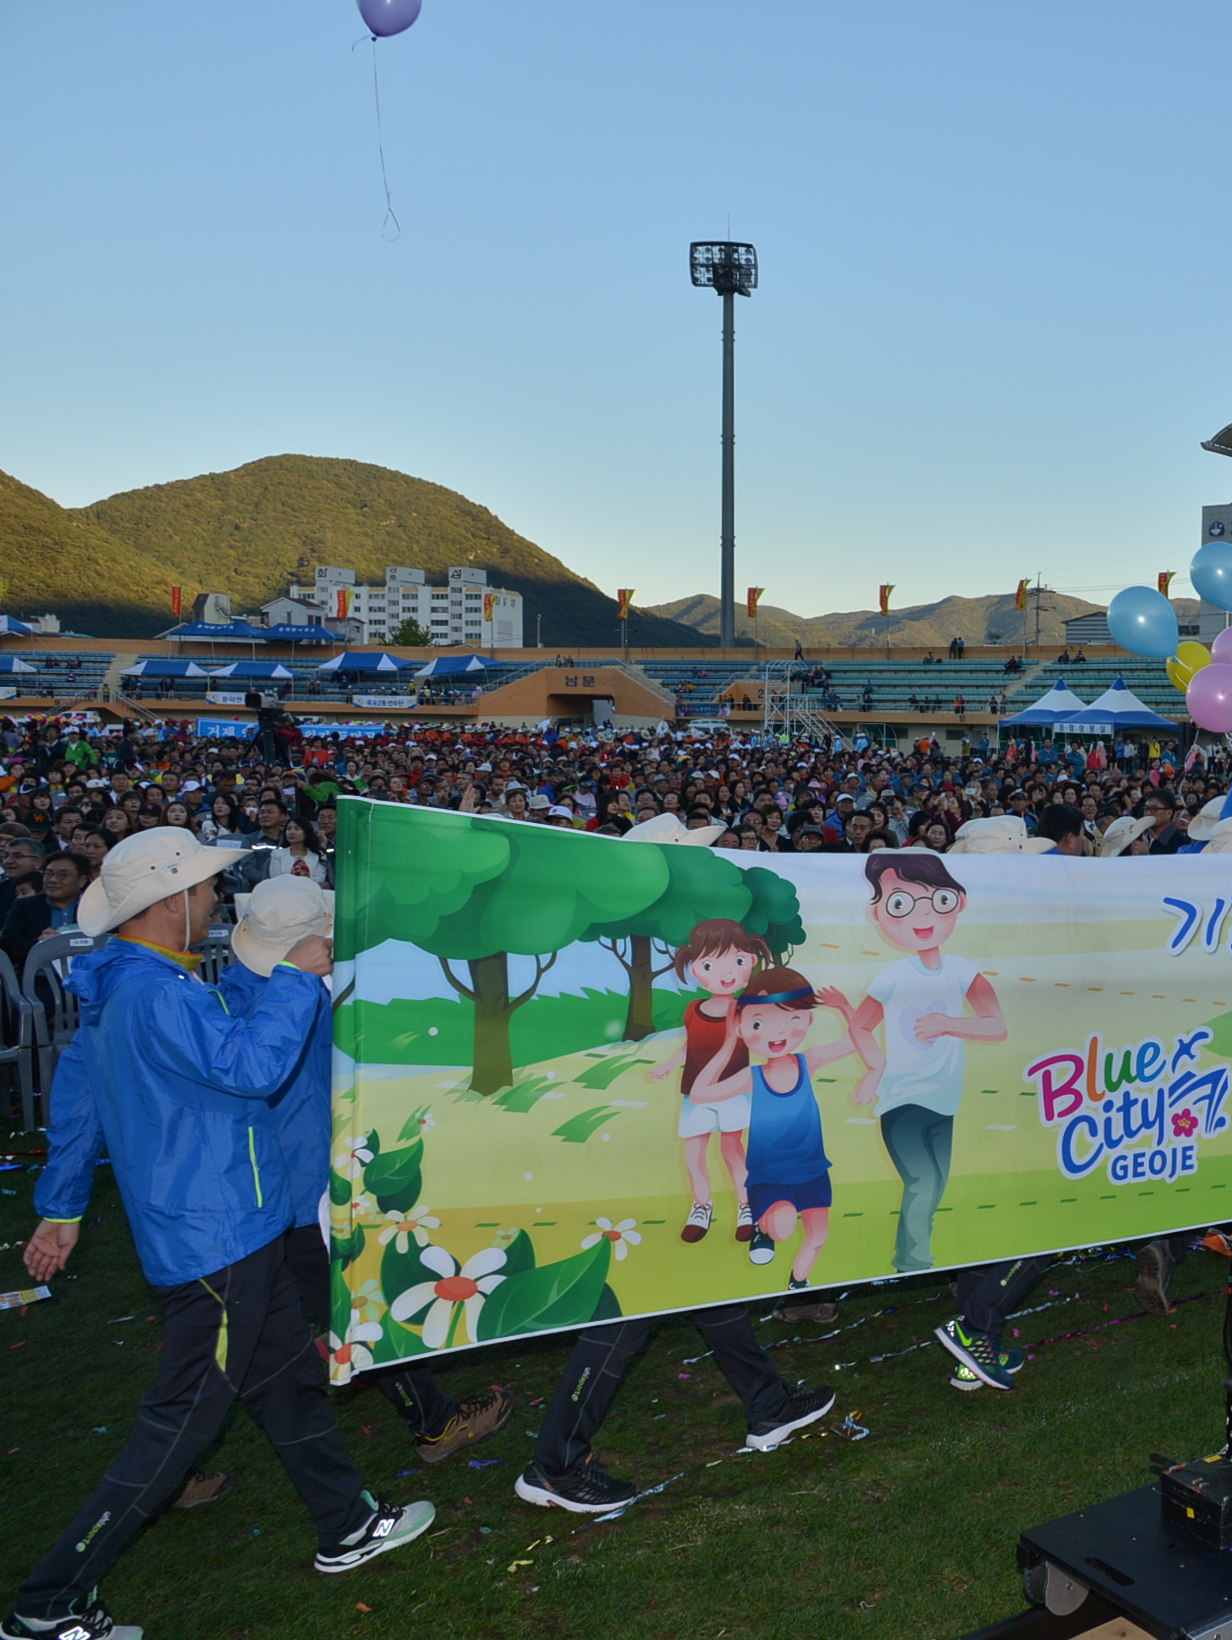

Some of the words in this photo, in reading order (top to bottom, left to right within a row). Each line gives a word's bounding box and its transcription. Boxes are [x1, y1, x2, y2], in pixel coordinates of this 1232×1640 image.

[1027, 1036, 1167, 1122] Blue
[1061, 1087, 1165, 1174] City
[1110, 1145, 1195, 1181] GEOJE
